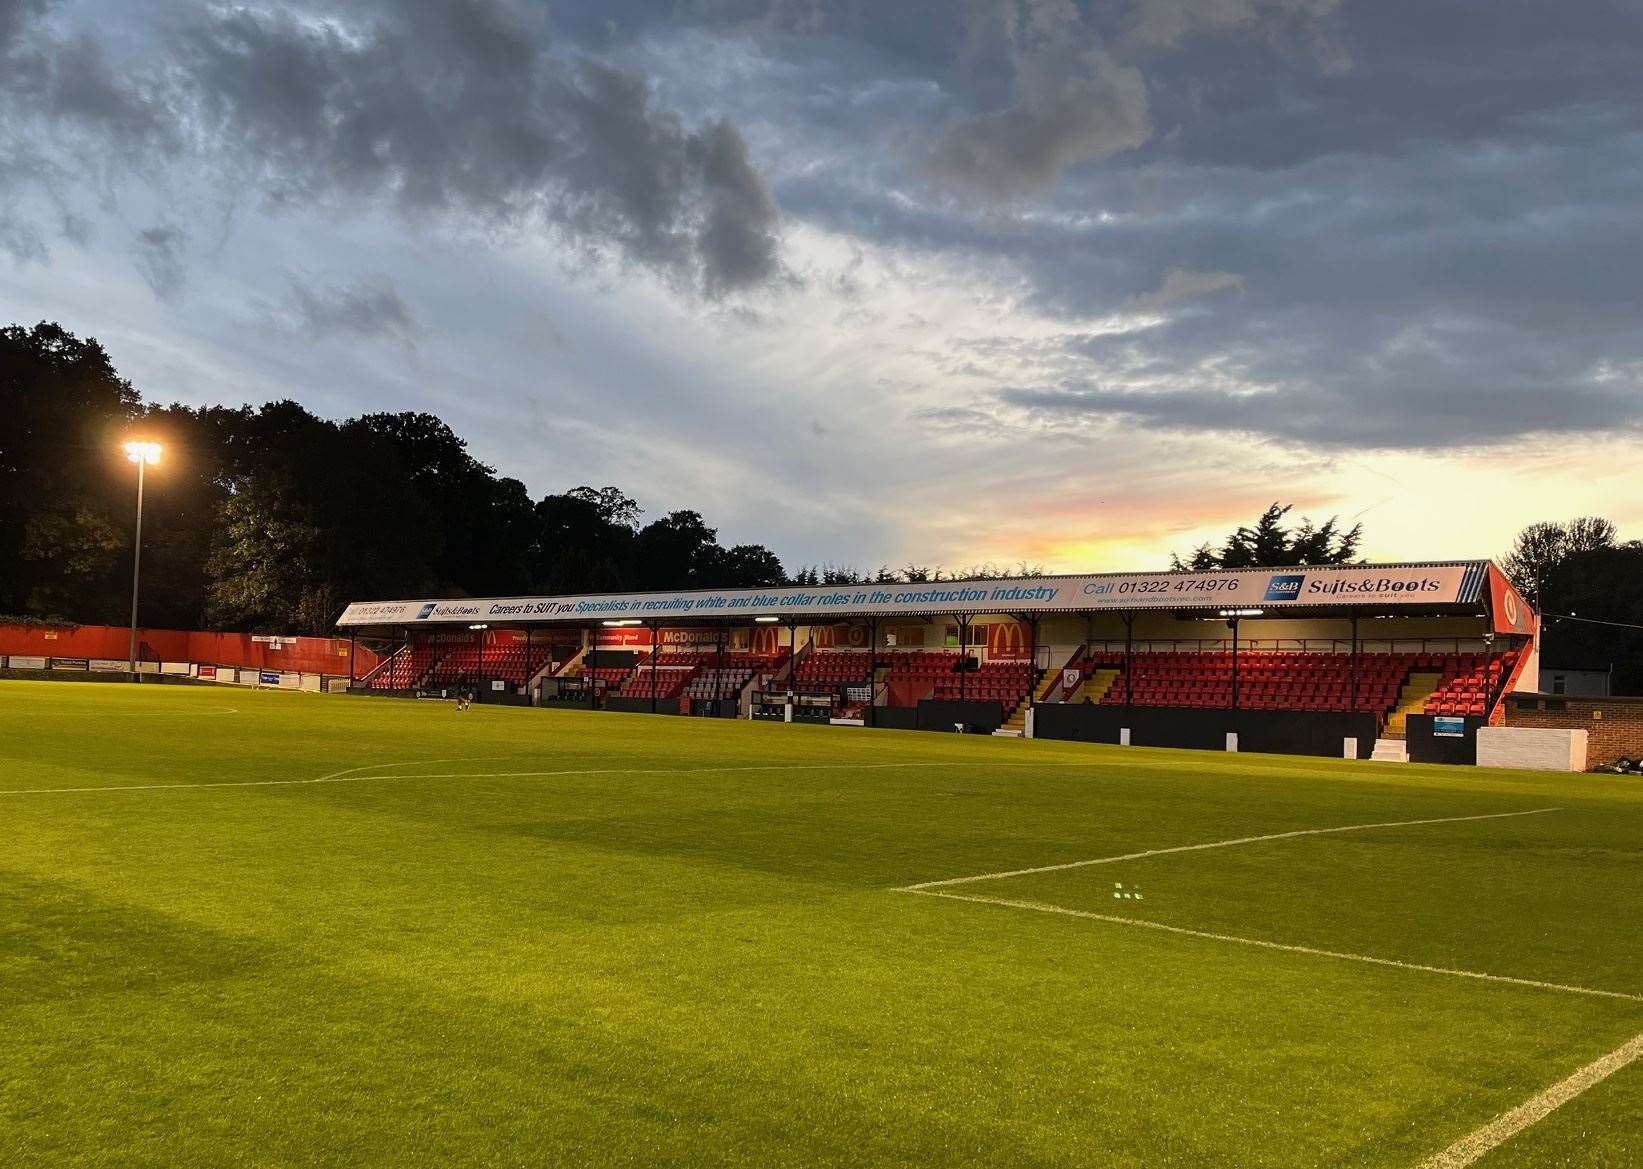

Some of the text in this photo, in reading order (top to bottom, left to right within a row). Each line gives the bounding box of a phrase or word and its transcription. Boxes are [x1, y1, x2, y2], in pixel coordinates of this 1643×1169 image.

[1083, 578, 1240, 595] Call 01322 474976
[1270, 581, 1299, 591] S&B
[1308, 577, 1441, 595] Suits&Boots
[489, 586, 1060, 615] Careers to SUIT you Specialists in recruiting white and blue collar roles in the construction industry
